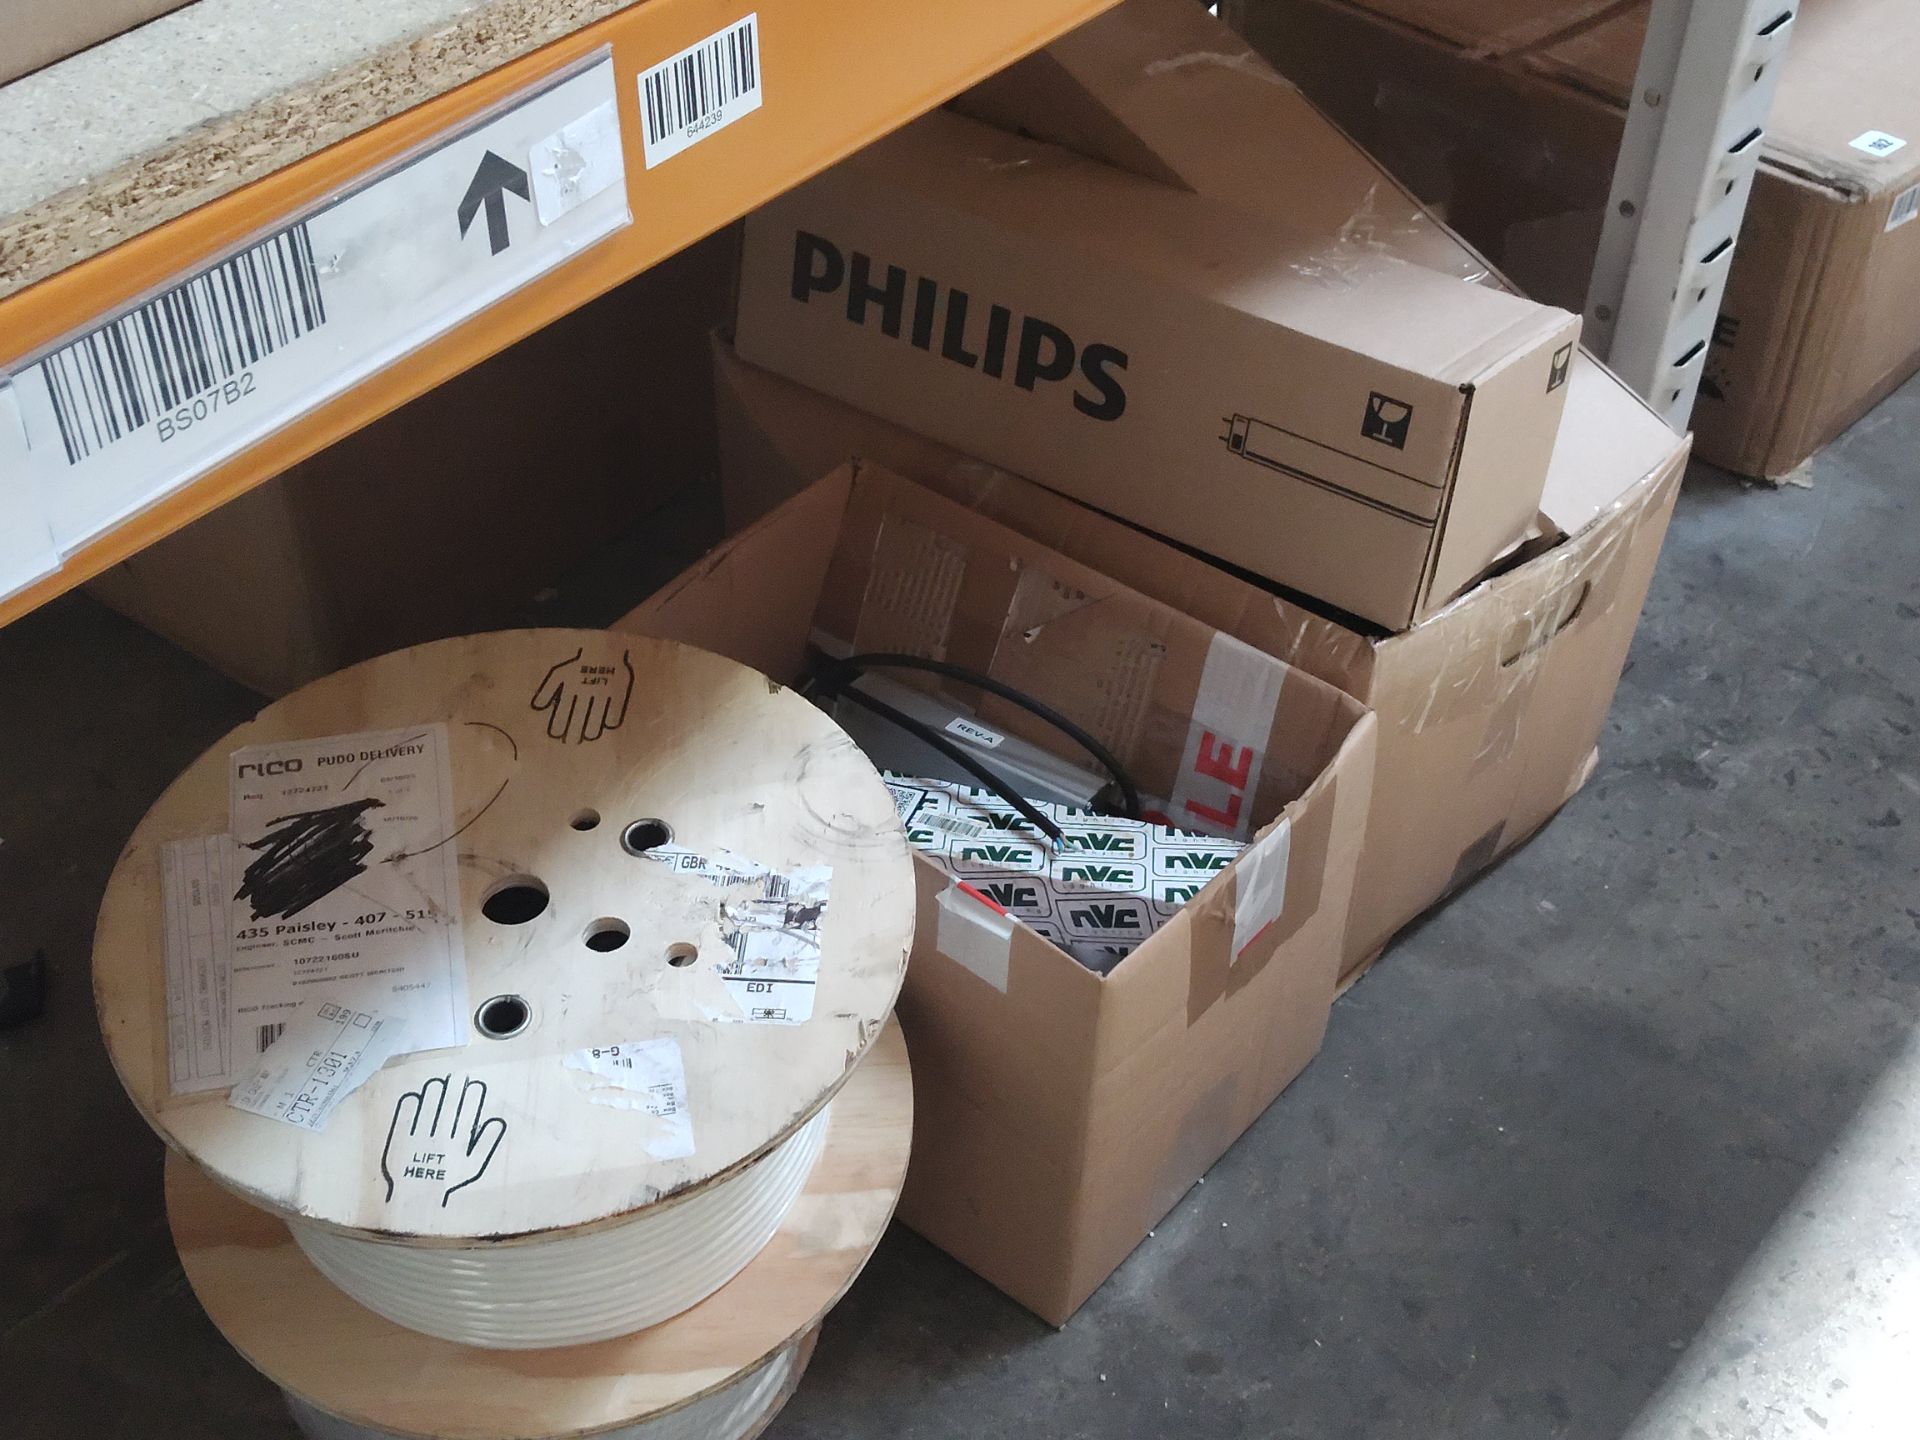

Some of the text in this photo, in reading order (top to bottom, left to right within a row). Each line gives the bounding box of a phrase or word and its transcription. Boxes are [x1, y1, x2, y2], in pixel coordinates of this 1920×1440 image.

[686, 110, 724, 139] 644239
[791, 229, 1129, 422] PHILIPS
[156, 373, 257, 443] BS07B2
[580, 665, 616, 675] HERE
[582, 677, 608, 686] LIFT
[957, 723, 993, 744] REV-A
[317, 743, 425, 767] PUDO DELIVERY
[236, 927, 269, 941] 435
[275, 920, 336, 936] Paisley
[354, 911, 387, 926] 407
[282, 936, 316, 947] SCMC
[334, 931, 362, 942] Scott
[746, 983, 774, 993] EDI
[261, 1001, 297, 1011] Tracking
[305, 1049, 323, 1068] CTR
[285, 1049, 348, 1124] CTR-1301
[412, 1152, 446, 1168] LIFT
[403, 1167, 447, 1183] HERE
